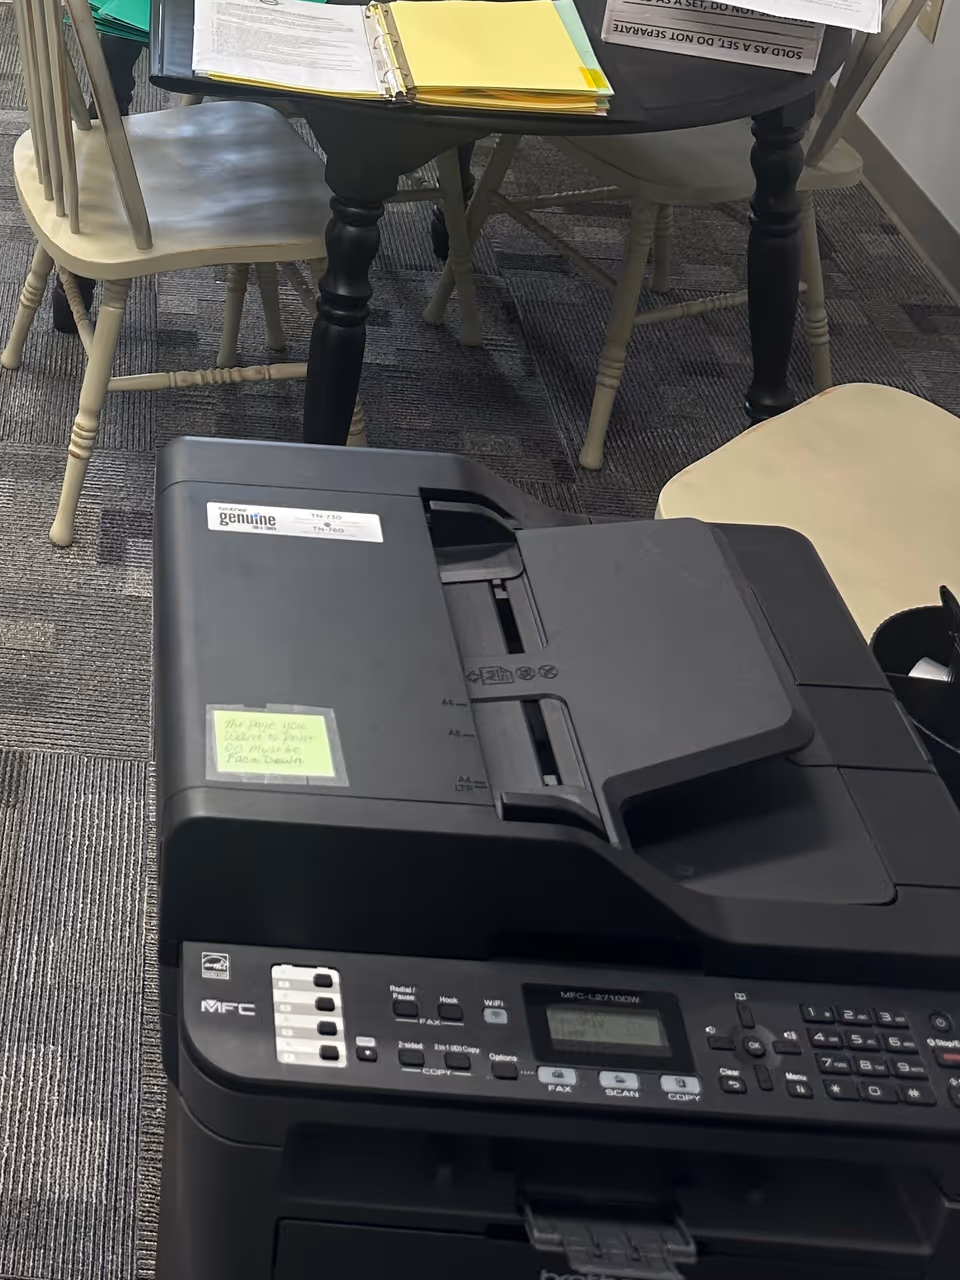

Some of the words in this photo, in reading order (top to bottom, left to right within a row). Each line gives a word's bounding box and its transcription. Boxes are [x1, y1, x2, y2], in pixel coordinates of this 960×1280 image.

[710, 1, 728, 12] DO
[612, 23, 667, 39] SEPARATE
[670, 31, 694, 43] NOT
[697, 36, 714, 46] DO
[718, 37, 739, 50] SET,
[743, 43, 751, 51] A
[754, 44, 769, 55] AS
[772, 47, 802, 60] SOLD
[219, 512, 276, 526] genuine
[201, 999, 256, 1015] MFC
[489, 1053, 517, 1062] Options
[720, 1068, 739, 1076] Clear
[605, 1088, 639, 1098] SCAN
[668, 1093, 701, 1102] COPY
